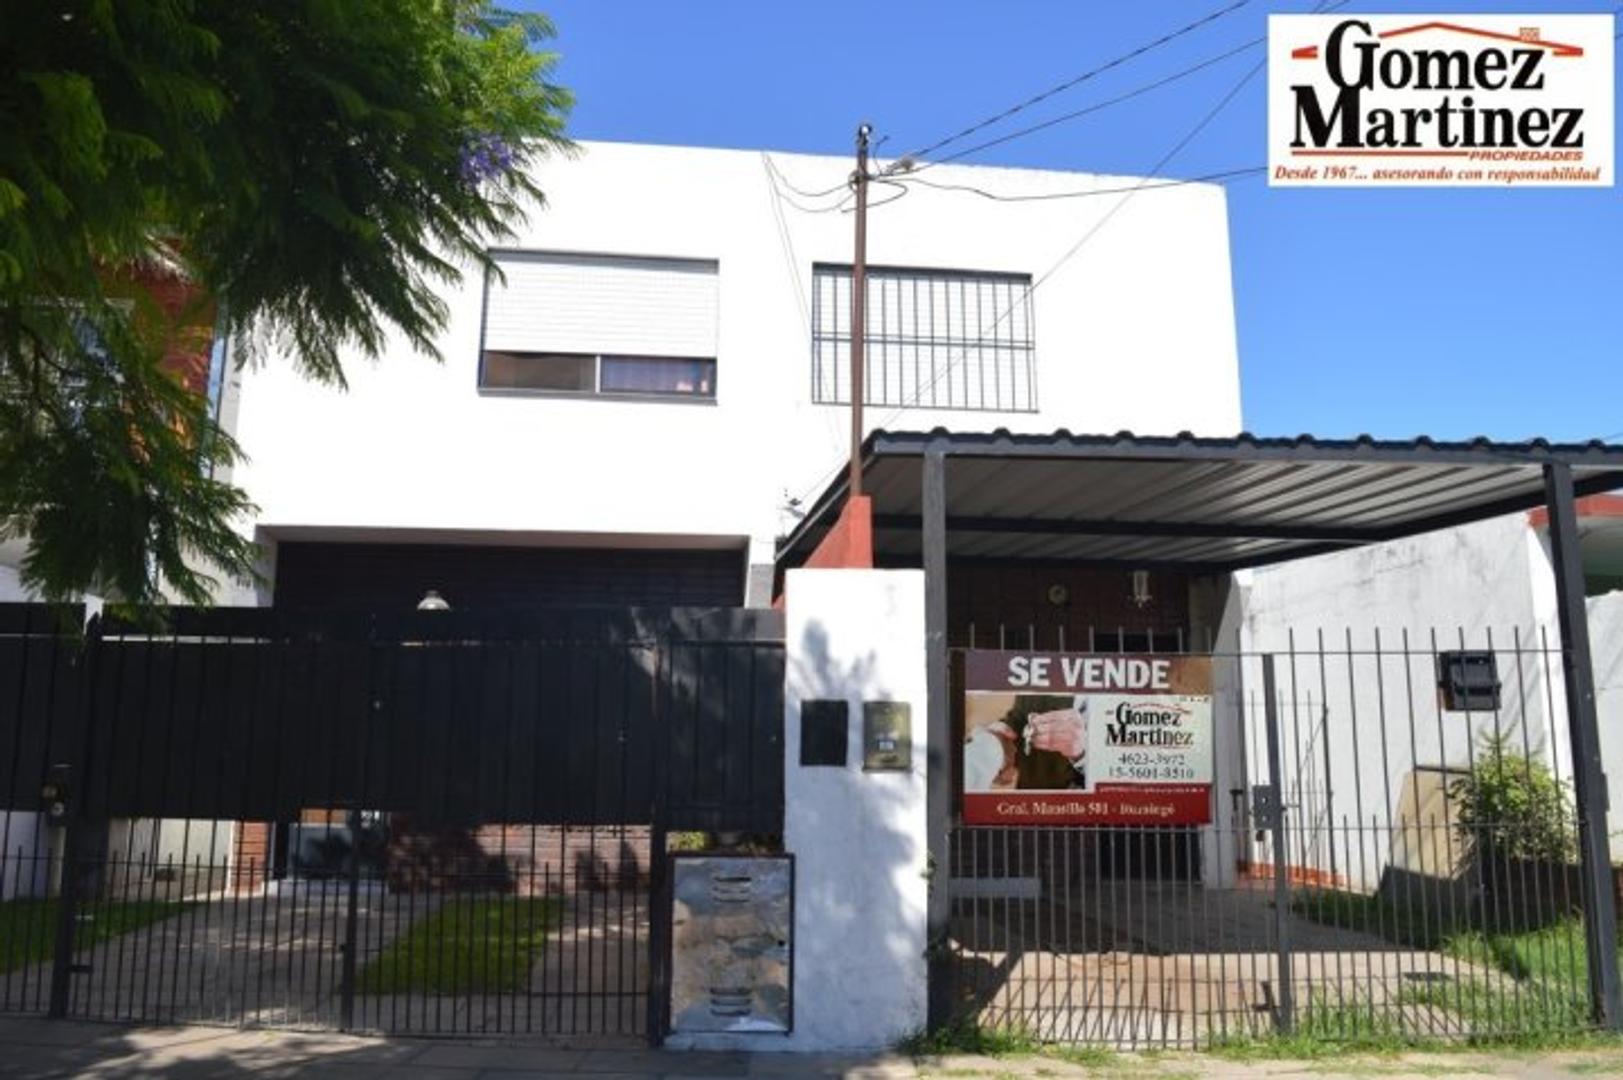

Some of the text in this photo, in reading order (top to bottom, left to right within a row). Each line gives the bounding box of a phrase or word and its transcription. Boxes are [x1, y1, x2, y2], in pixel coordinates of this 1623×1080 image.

[1007, 655, 1171, 690] SE VENDE
[1116, 700, 1183, 727] Gomez
[1105, 724, 1195, 746] Martinez
